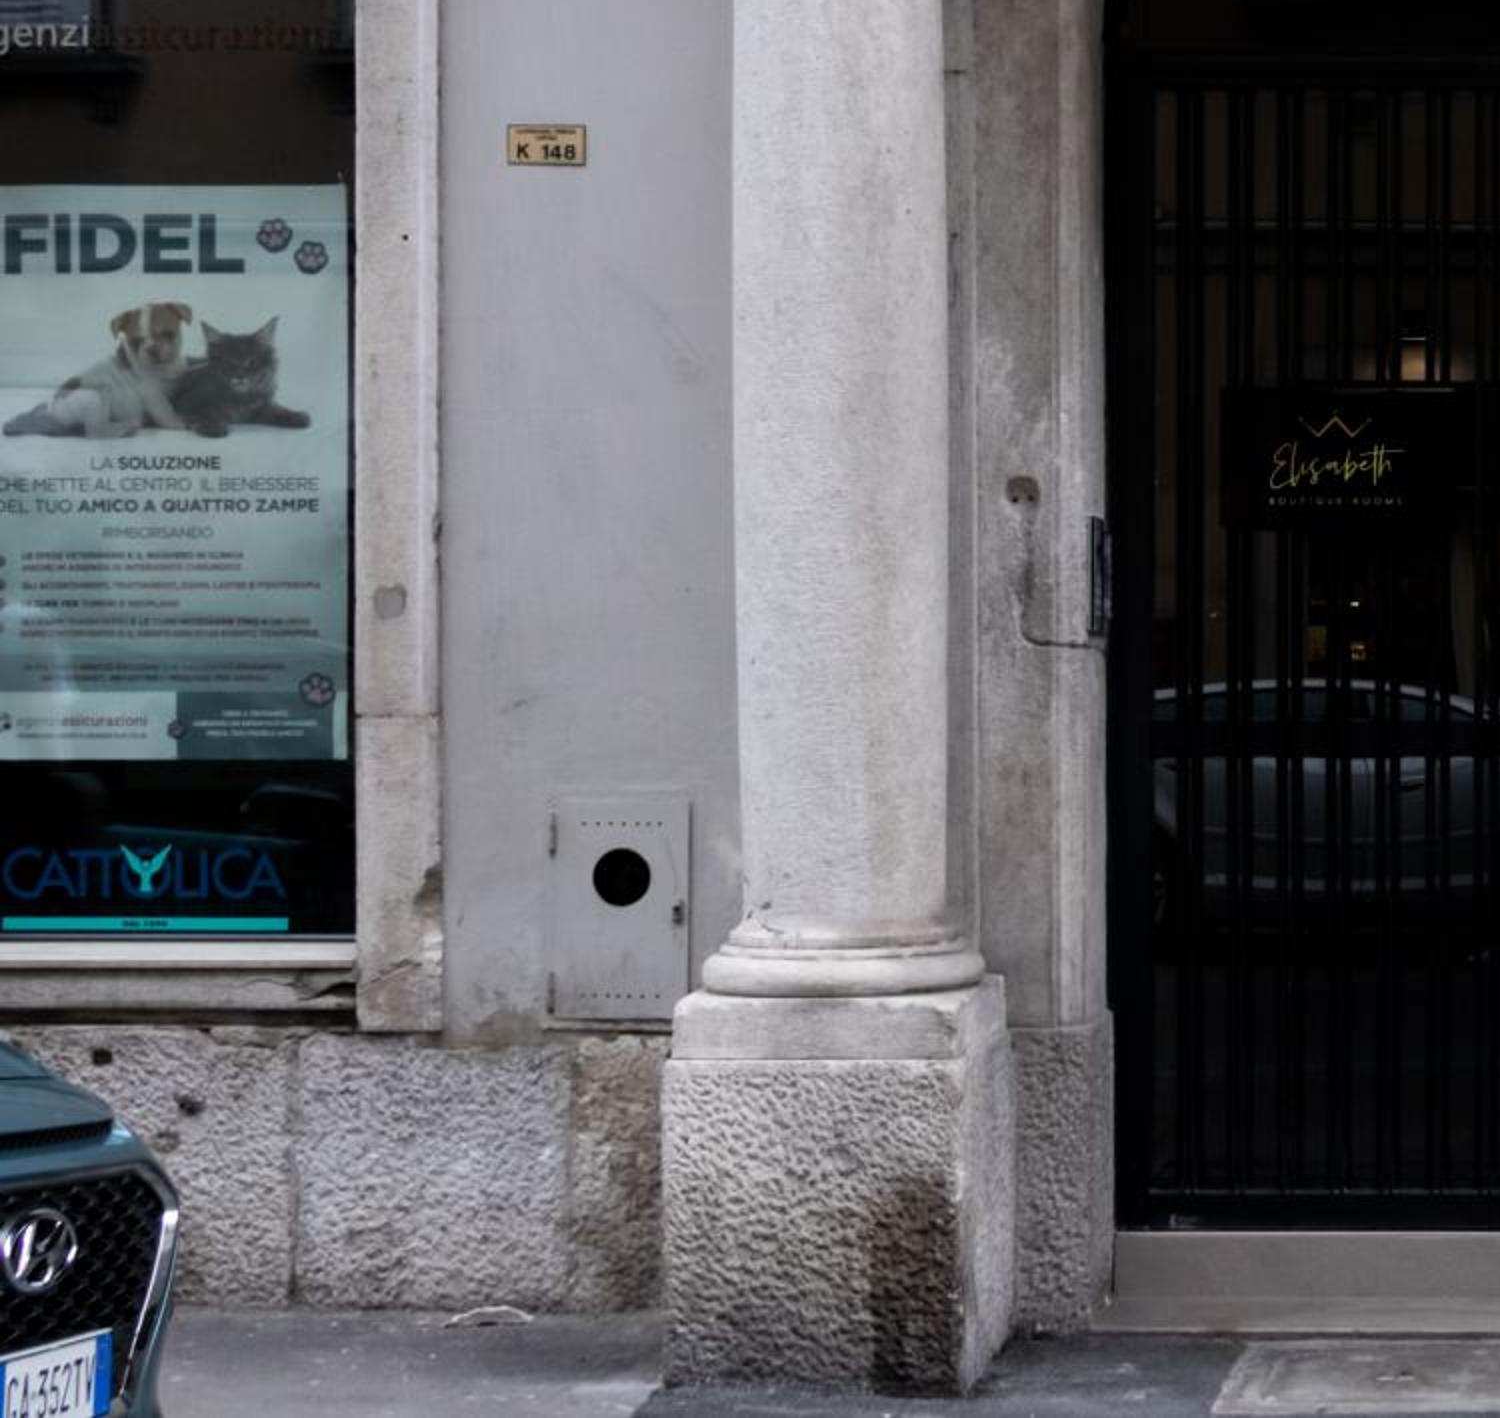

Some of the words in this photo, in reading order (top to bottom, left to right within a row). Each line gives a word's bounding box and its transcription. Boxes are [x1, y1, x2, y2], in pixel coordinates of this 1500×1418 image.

[516, 142, 529, 159] K
[543, 144, 577, 160] 148
[4, 213, 246, 274] FIDEL
[90, 455, 113, 471] LA
[118, 455, 221, 471] SOLUZIONE
[1268, 440, 1406, 490] Elisabeth
[33, 476, 91, 493] METTE
[96, 476, 117, 493] AL
[120, 476, 193, 493] CENTRO
[218, 476, 319, 493] BENESSERE
[35, 498, 73, 514] TUO
[77, 498, 139, 513] AMICO
[143, 498, 157, 513] A
[160, 498, 251, 513] QUATTRO
[255, 498, 320, 513] ZAMPE
[1, 844, 289, 902] CATTOLICA
